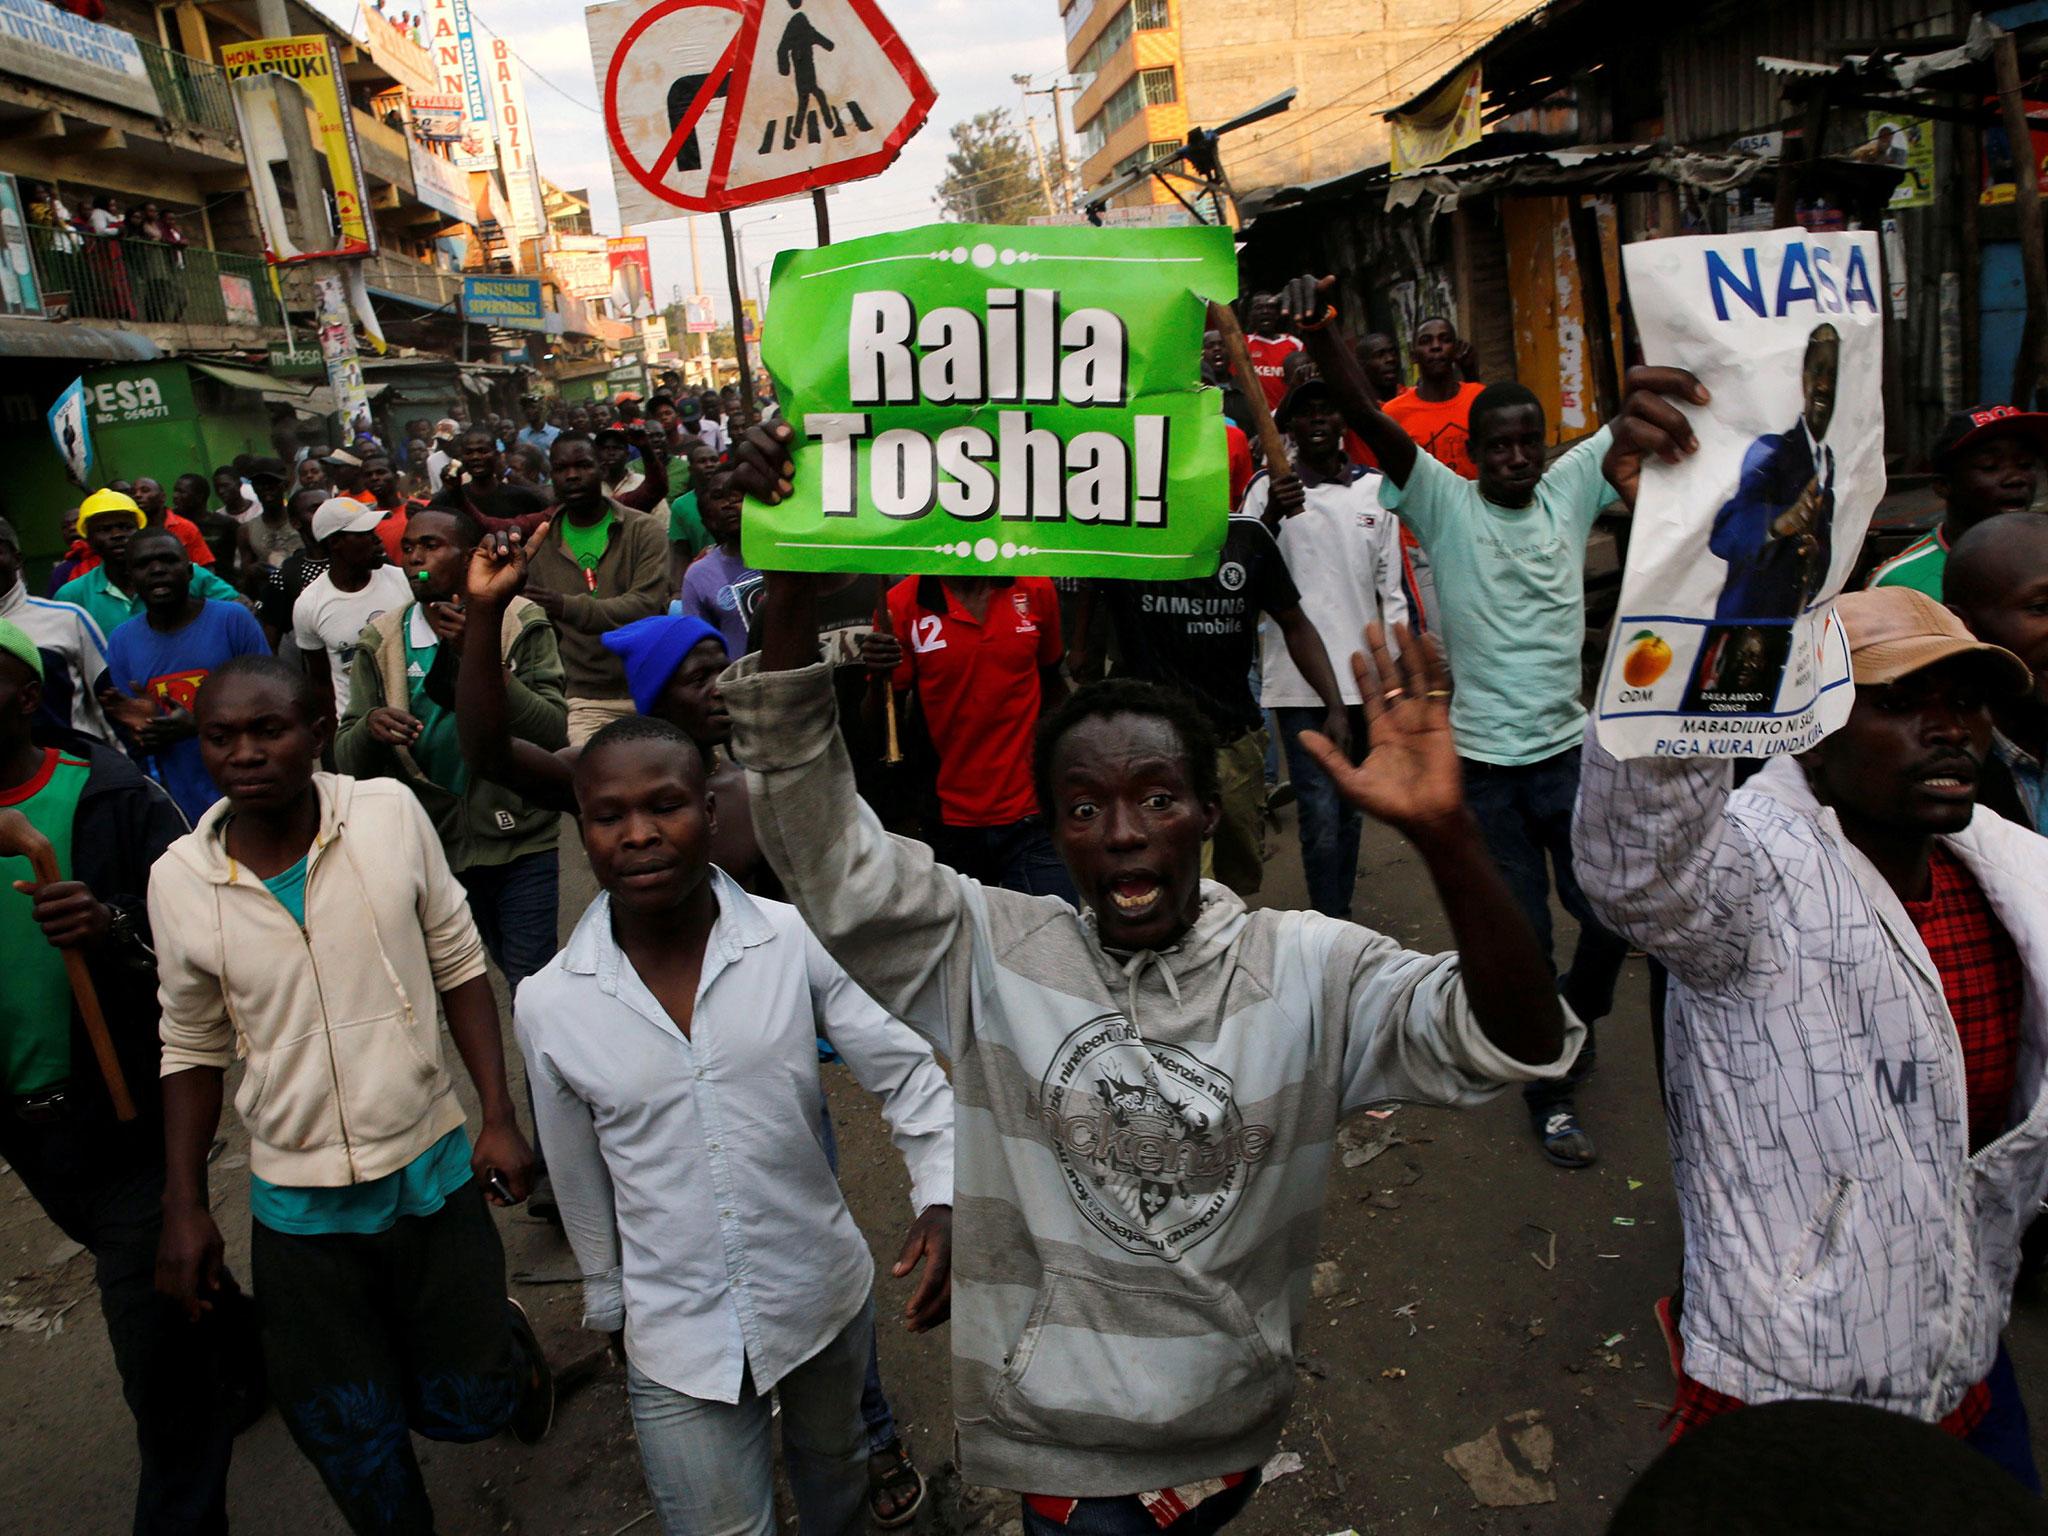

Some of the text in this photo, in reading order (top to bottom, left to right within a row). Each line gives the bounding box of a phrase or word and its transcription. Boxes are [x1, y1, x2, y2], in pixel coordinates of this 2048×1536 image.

[225, 42, 323, 66] HON. STEVEN
[492, 38, 524, 170] BALOZI
[1704, 241, 1880, 321] NASA
[848, 288, 1129, 408] Raila
[1253, 365, 1285, 377] KEN
[803, 410, 1172, 529] Tosha!
[1141, 594, 1246, 616] SAMSUNG
[1186, 617, 1243, 635] mobile
[1618, 690, 1655, 704] ODM
[1709, 703, 1748, 712] ODINGA
[1680, 718, 1783, 735] MABADILIKO
[1785, 721, 1799, 734] NI
[1654, 739, 1700, 756] PIGA
[1706, 739, 1753, 755] KURA
[1765, 736, 1805, 755] LINDA
[1151, 1051, 1206, 1089] kenzie
[1025, 1090, 1273, 1177] mckenzie
